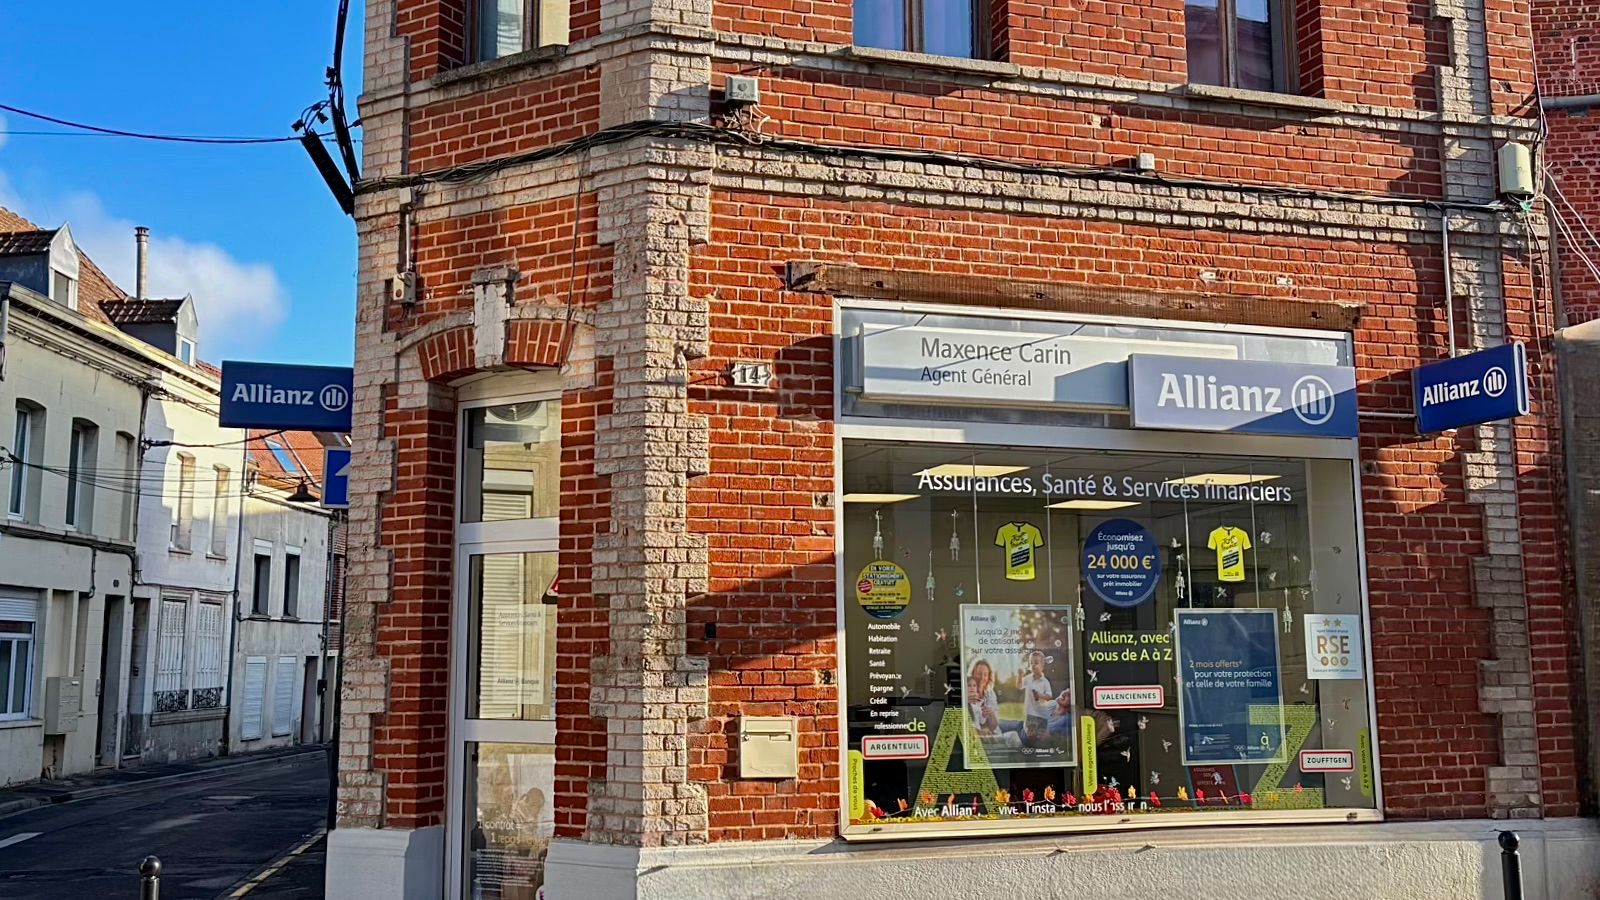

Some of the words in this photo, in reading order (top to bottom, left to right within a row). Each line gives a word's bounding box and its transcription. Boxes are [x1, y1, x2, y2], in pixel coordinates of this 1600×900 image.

[920, 337, 1012, 362] Maxence
[1018, 343, 1071, 365] Carin
[920, 366, 967, 386] Agent
[972, 368, 1032, 387] Général
[231, 383, 314, 405] Allianz
[1157, 373, 1283, 413] Allianz
[1422, 379, 1480, 407] Allianz
[918, 469, 1037, 497] Assurances,
[1042, 474, 1097, 496] Santé
[1102, 476, 1117, 496] &
[1122, 476, 1200, 499] Services
[1205, 479, 1292, 502] financiers
[1097, 530, 1144, 542] Économisez
[1087, 554, 1107, 570] 24
[1110, 554, 1139, 570] 000
[1103, 580, 1115, 588] prêt
[867, 622, 901, 630] Automobile
[1004, 627, 1009, 635] 2
[868, 635, 898, 643] Habitation
[1090, 631, 1137, 646] Allianz,
[1140, 633, 1170, 644] avec
[1317, 635, 1350, 654] RSE
[868, 647, 891, 655] Retraite
[1089, 651, 1118, 661] vous
[1121, 648, 1137, 661] de
[1140, 649, 1150, 660] A
[1152, 649, 1160, 661] à
[1163, 649, 1173, 660] Z
[869, 659, 886, 667] Santé
[1189, 660, 1194, 668] 2
[1196, 660, 1214, 668] mois
[1194, 671, 1212, 680] pour
[1233, 669, 1272, 679] protection
[869, 684, 894, 694] Epargne
[1195, 680, 1213, 688] celle
[1214, 680, 1224, 688] de
[1246, 679, 1272, 688] famille
[869, 697, 888, 705] Crédit
[908, 718, 926, 732] de
[1261, 731, 1269, 746] à
[914, 806, 940, 818] Avec
[1078, 802, 1102, 812] nous
